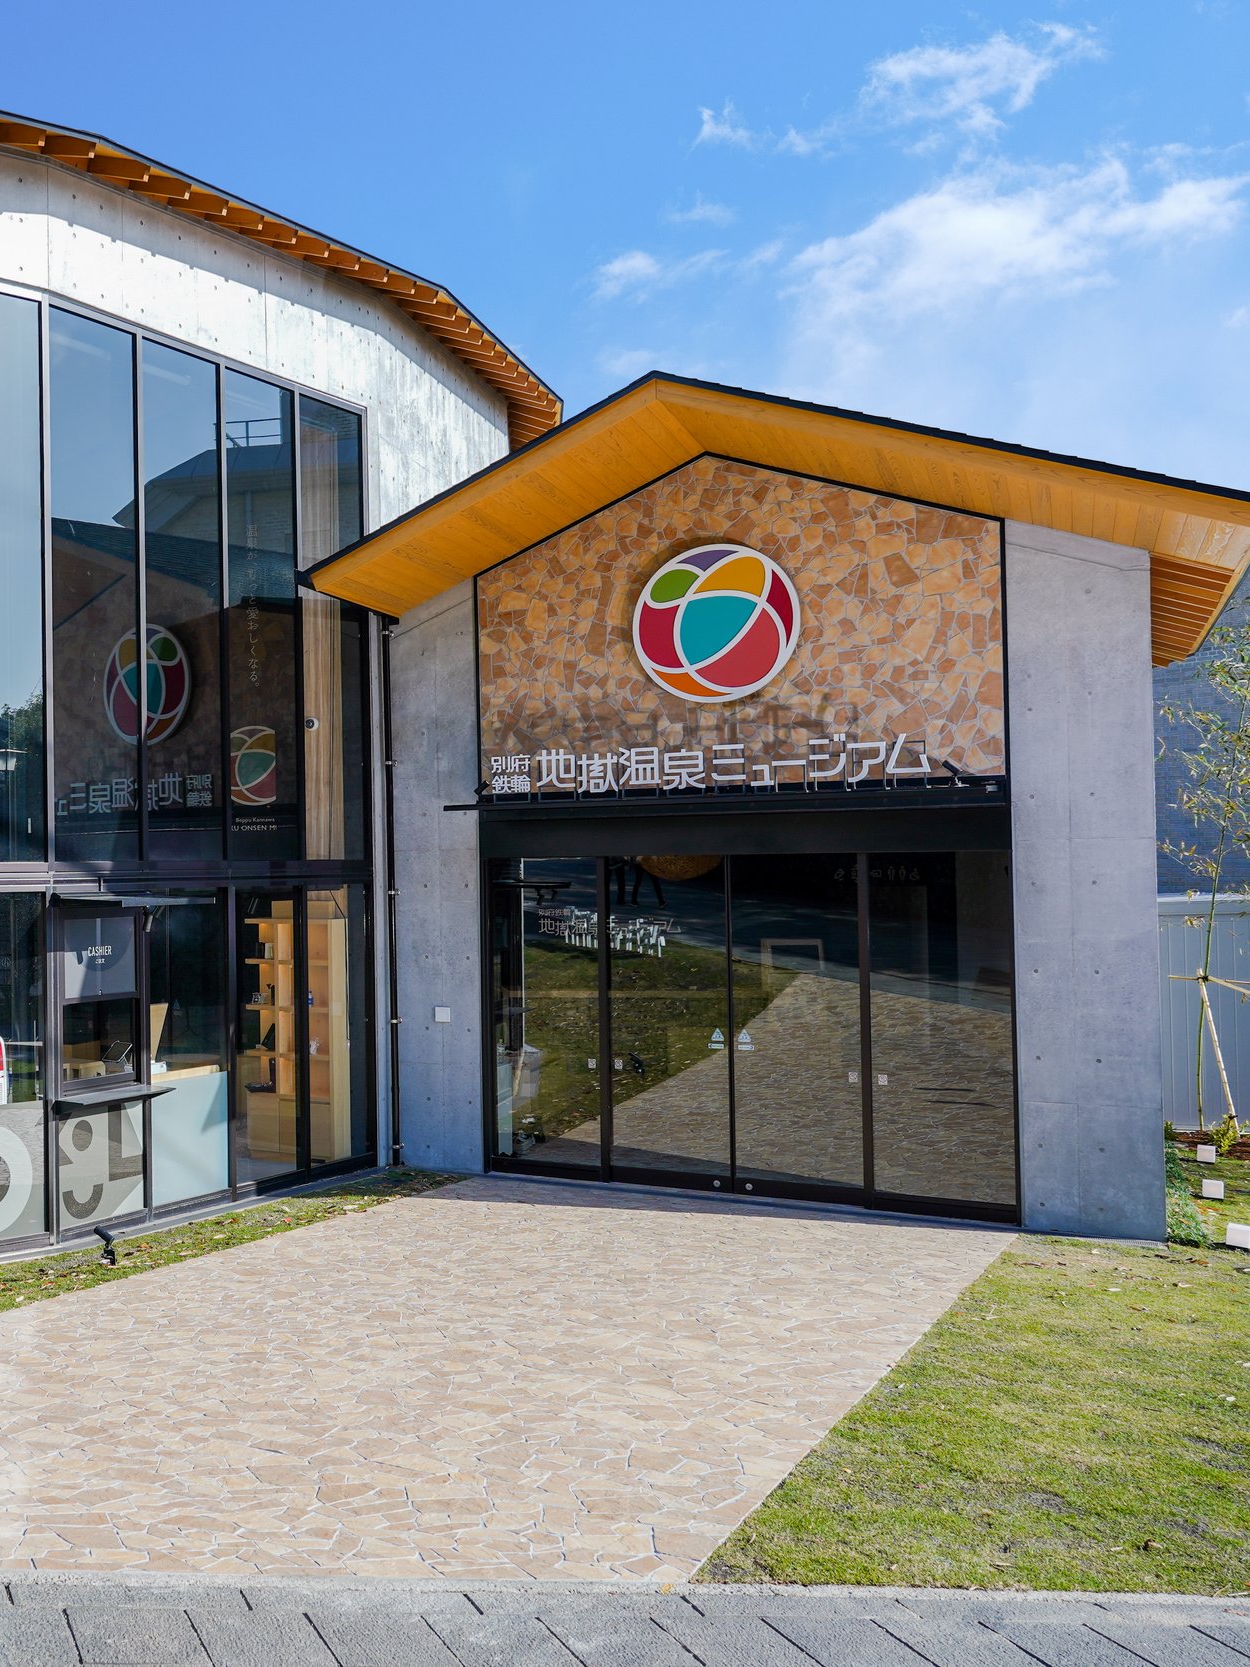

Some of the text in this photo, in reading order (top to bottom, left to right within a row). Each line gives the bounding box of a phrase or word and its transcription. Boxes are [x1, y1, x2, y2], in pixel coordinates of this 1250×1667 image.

[490, 754, 531, 773] 別府
[536, 733, 932, 793] 地獄温泉ミュージアム
[491, 774, 531, 794] 鉄輪
[87, 945, 112, 957] CASHIER
